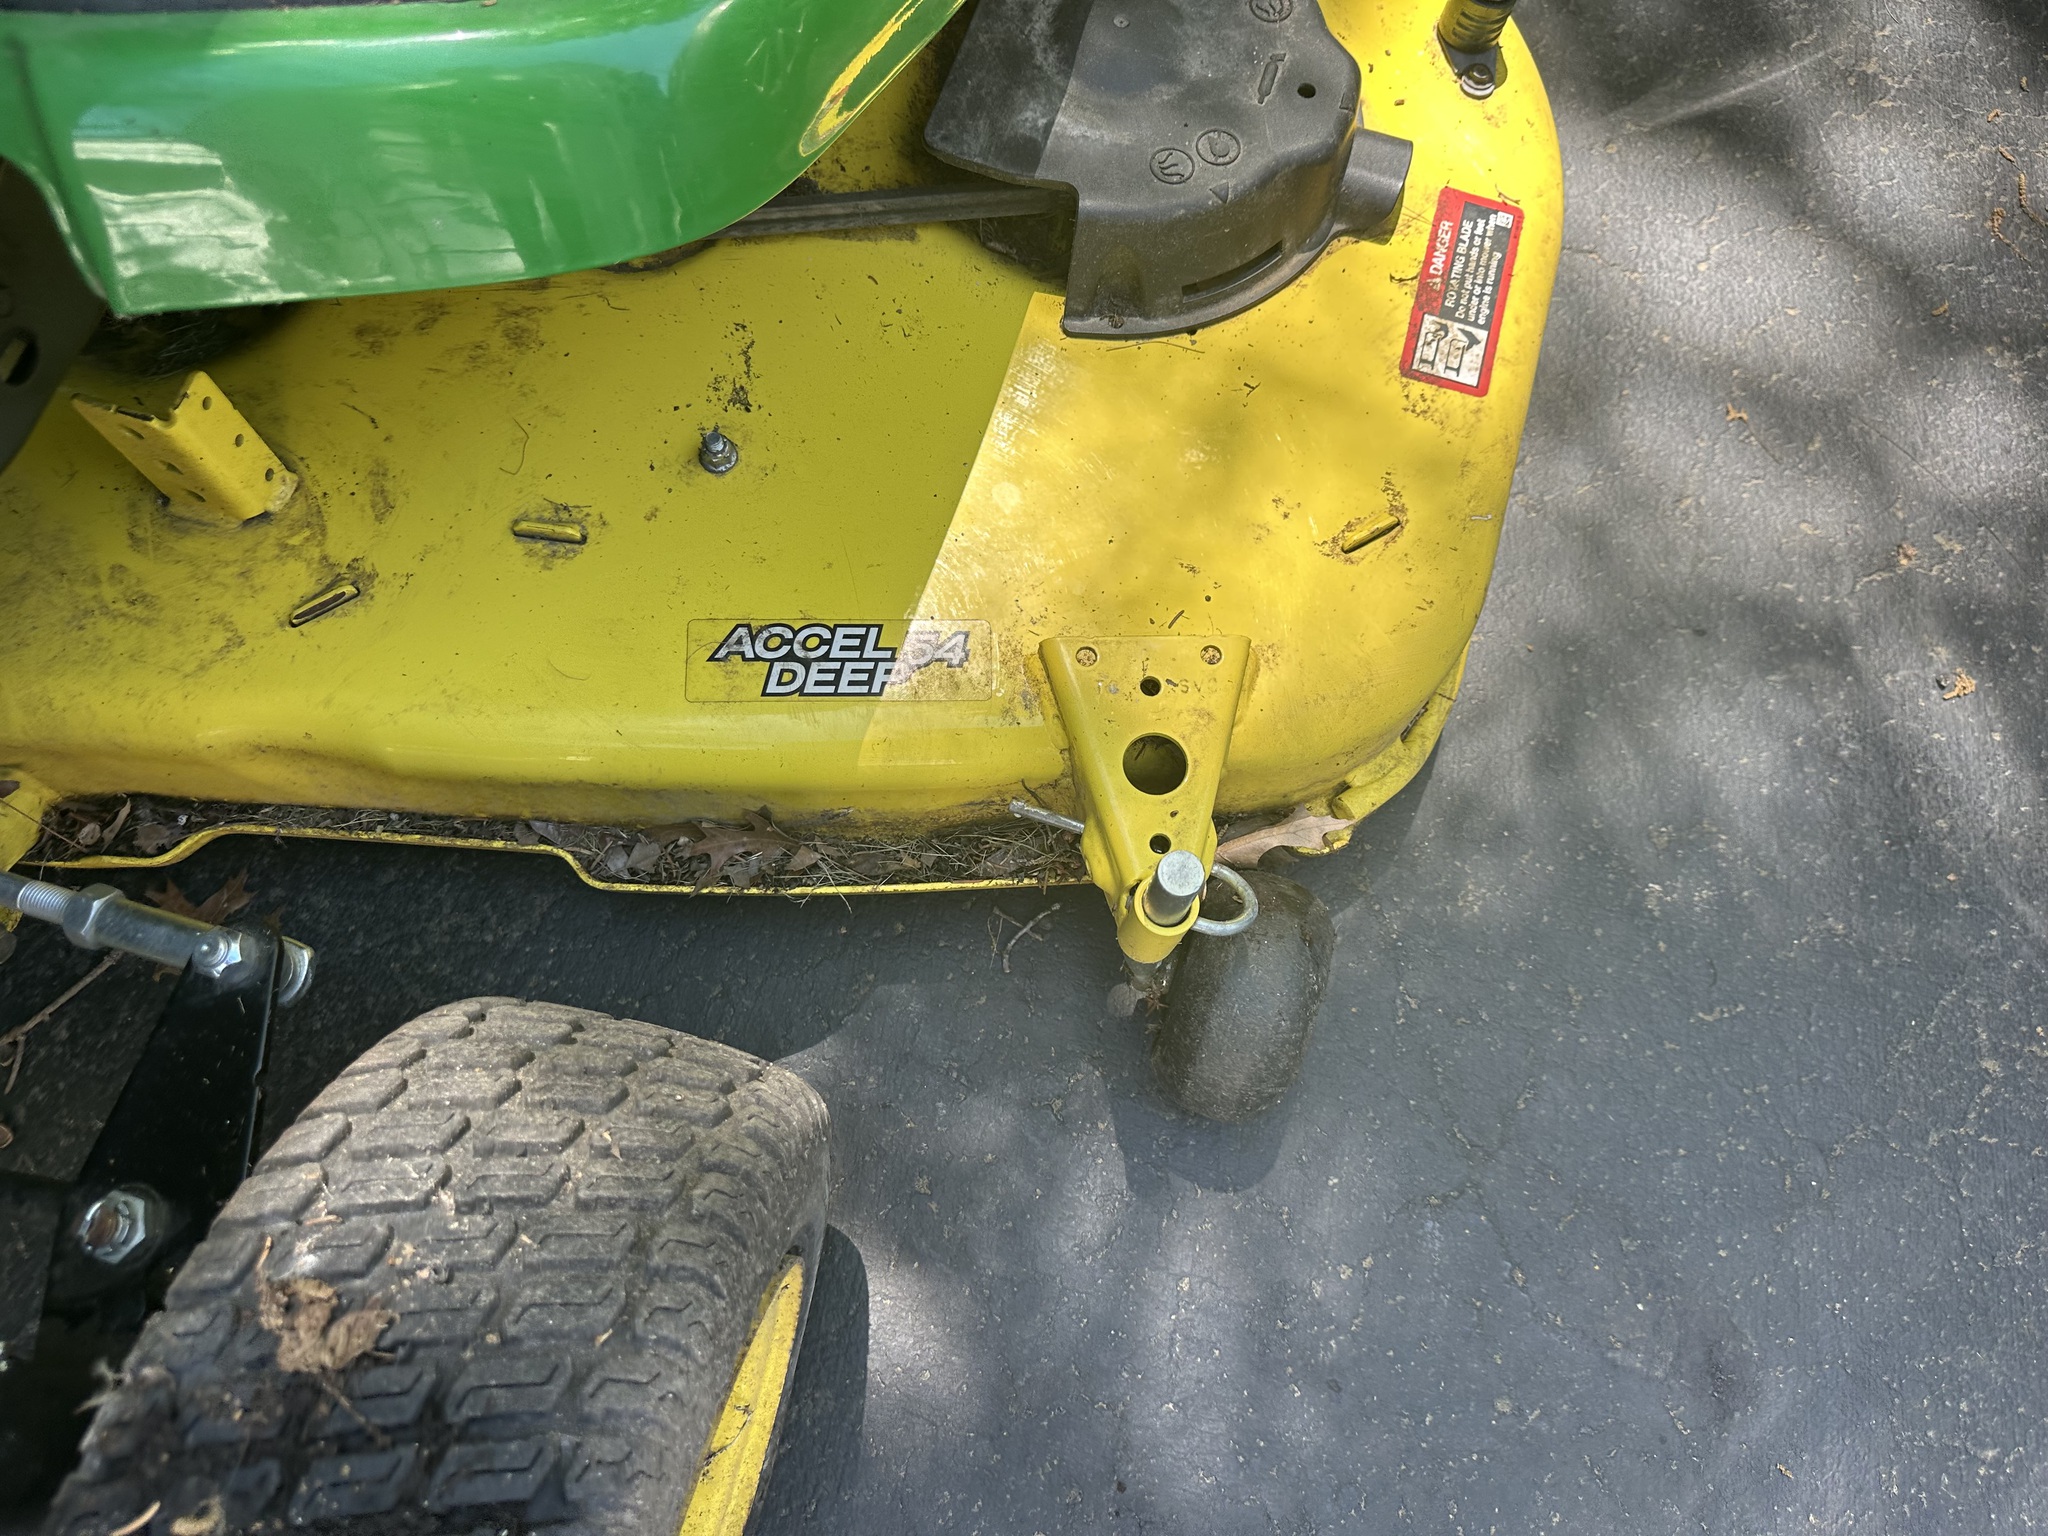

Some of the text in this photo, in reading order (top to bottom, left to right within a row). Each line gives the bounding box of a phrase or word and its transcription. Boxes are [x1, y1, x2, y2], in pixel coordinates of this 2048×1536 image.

[1429, 220, 1454, 275] DANGER
[1444, 219, 1474, 308] ROTATING BLADE
[1455, 218, 1487, 319] Do not put hands or feet
[1467, 213, 1497, 322] under or into mower when
[1477, 251, 1503, 325] engine is running
[706, 623, 972, 668] ACCEL 54
